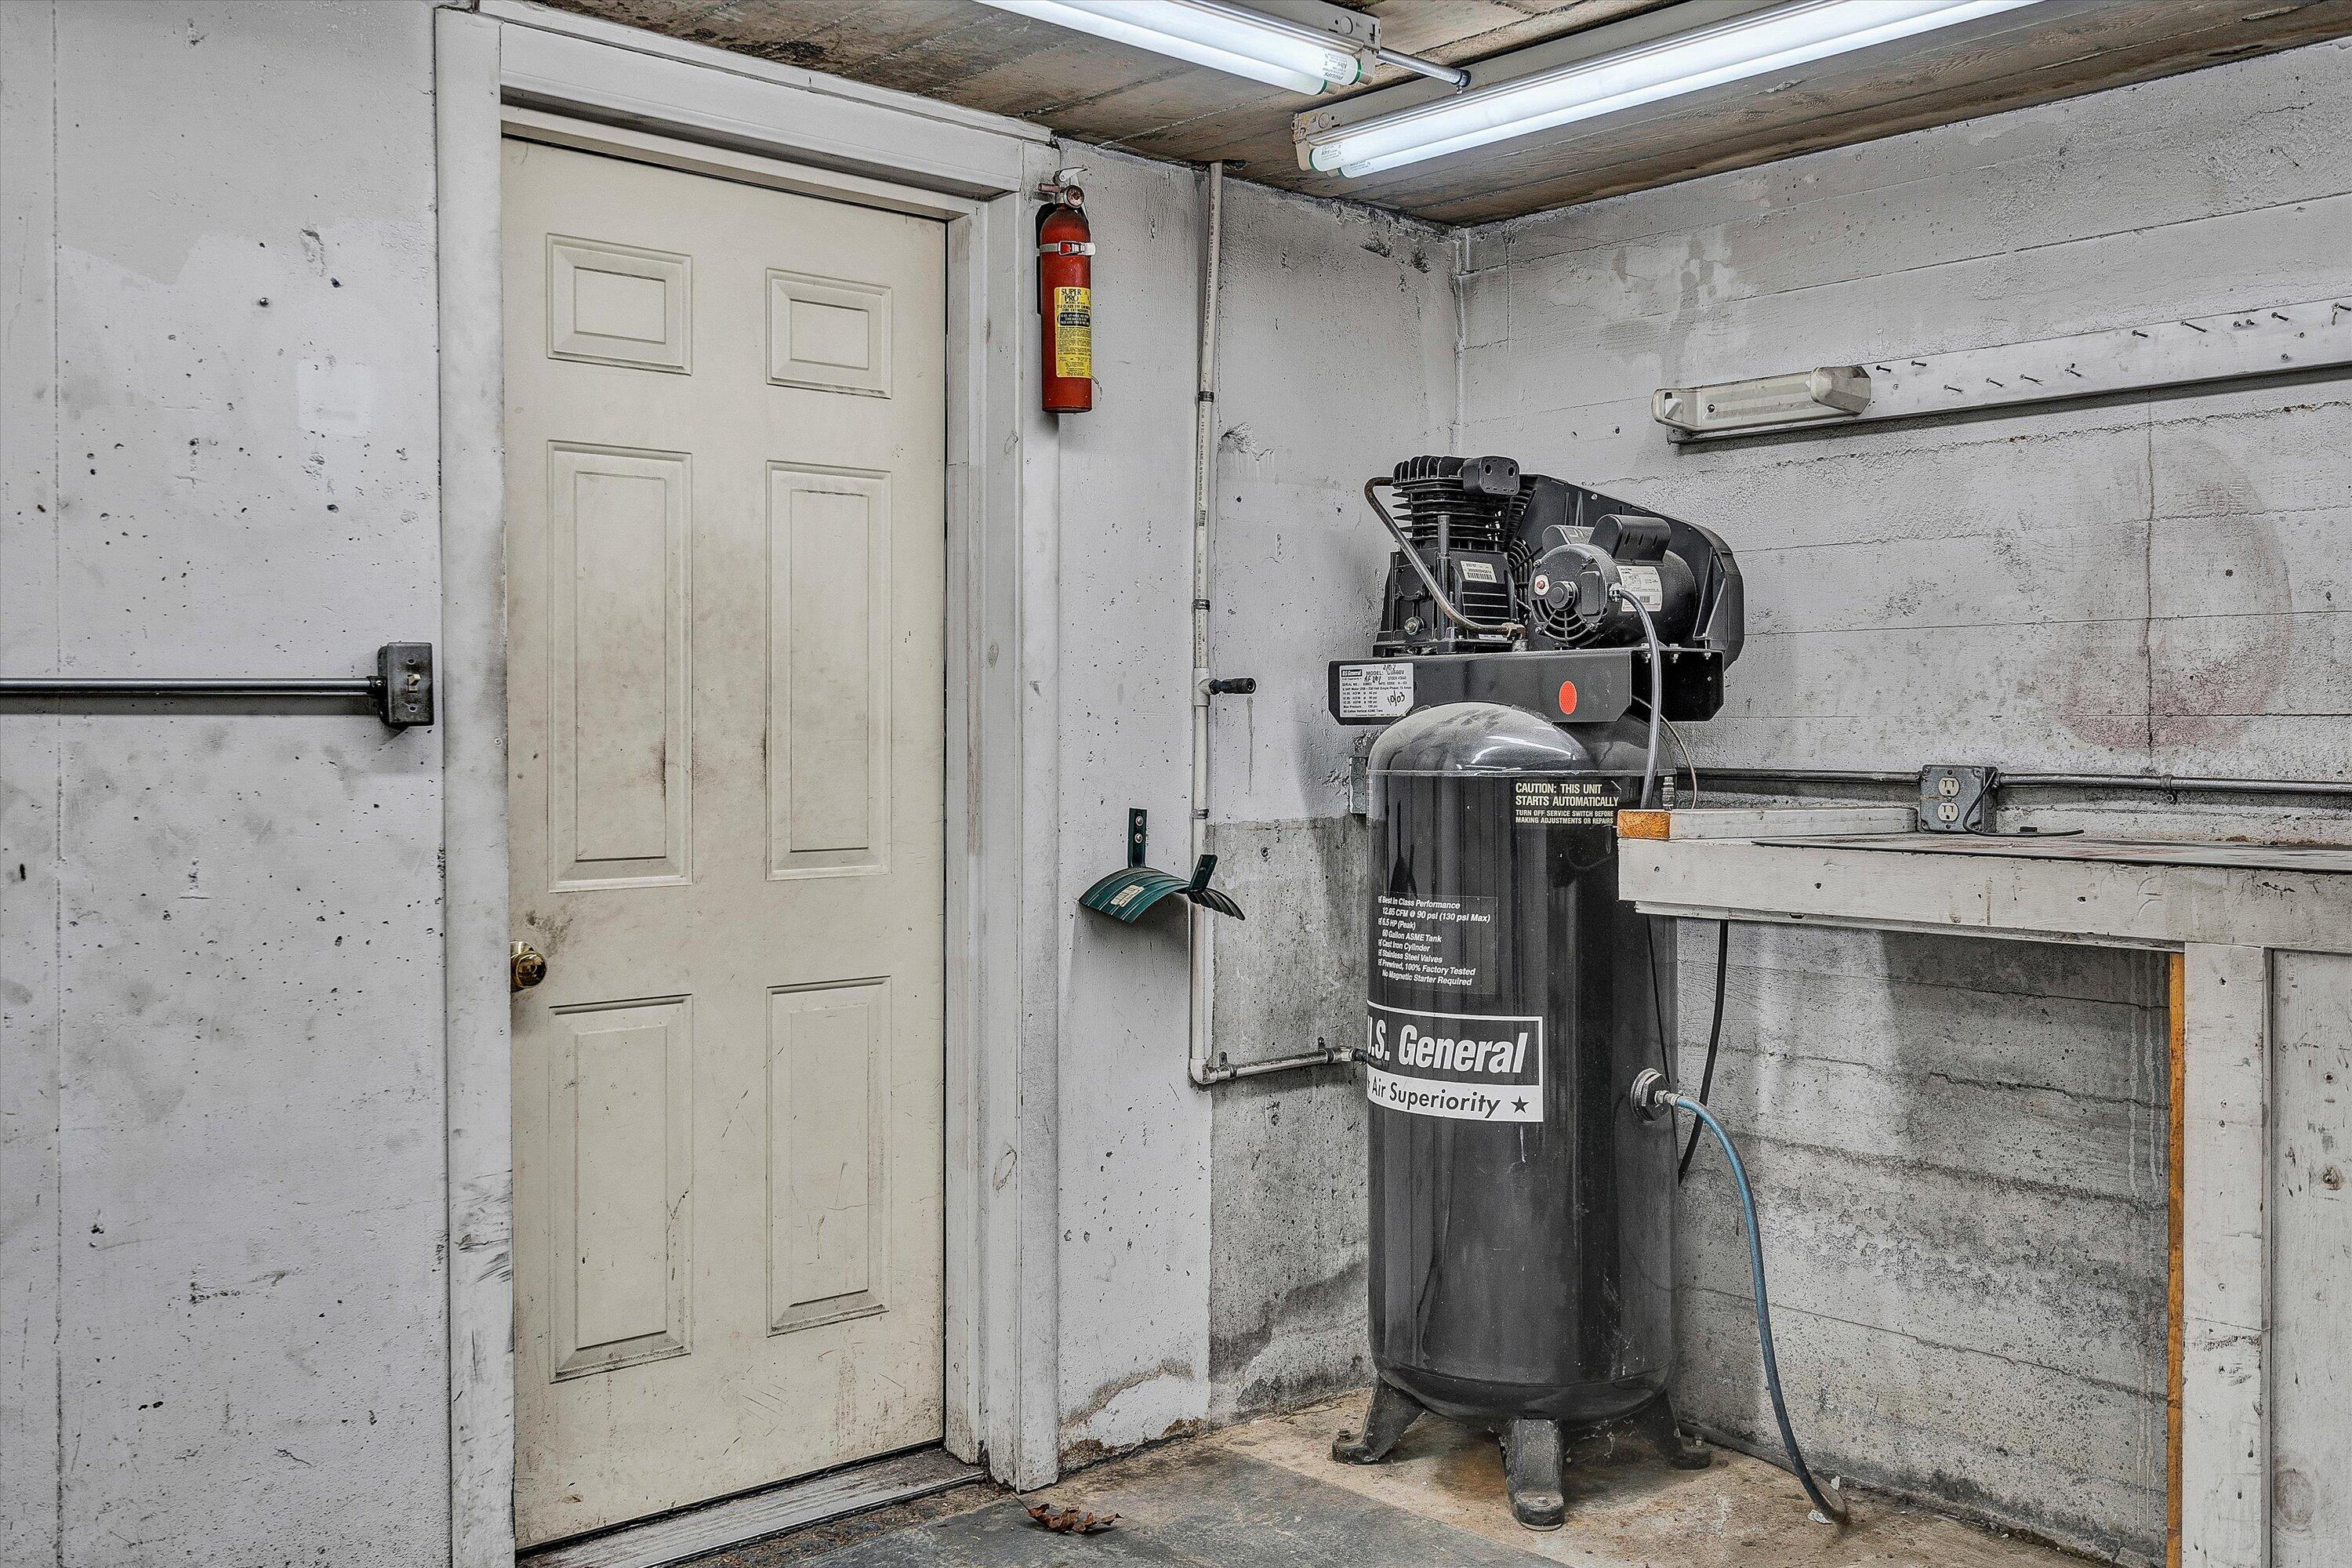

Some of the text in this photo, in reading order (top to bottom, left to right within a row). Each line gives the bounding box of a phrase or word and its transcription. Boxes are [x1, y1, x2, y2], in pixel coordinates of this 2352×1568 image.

[1387, 690, 1405, 706] 10/03
[1515, 782, 1602, 794] CAUTION: THIS UNIT
[1515, 795, 1619, 807] STARTS AUTOMATICALLY
[1382, 895, 1392, 905] Best
[1399, 898, 1414, 906] Class
[1416, 899, 1460, 909] Performance
[1382, 907, 1395, 916] 12.85
[1396, 909, 1408, 917] CFM
[1417, 910, 1426, 919] 90
[1427, 912, 1438, 920] psi
[1439, 913, 1455, 921] (130
[1456, 913, 1469, 922] psi
[1470, 913, 1491, 924] Max)
[1398, 920, 1416, 930] (Peak)
[1388, 931, 1404, 939] Gallon
[1406, 932, 1425, 941] ASME
[1404, 942, 1430, 952] Cylinder
[1382, 949, 1403, 958] Stainless
[1421, 954, 1443, 963] Valves
[1382, 959, 1475, 975] Prewired, 100% Factory Tested
[1389, 971, 1412, 981] Magnetic
[1414, 975, 1436, 983] Starter
[1438, 977, 1472, 986] Required
[1399, 1025, 1529, 1073] General
[1372, 1076, 1501, 1118] Air Superiority
